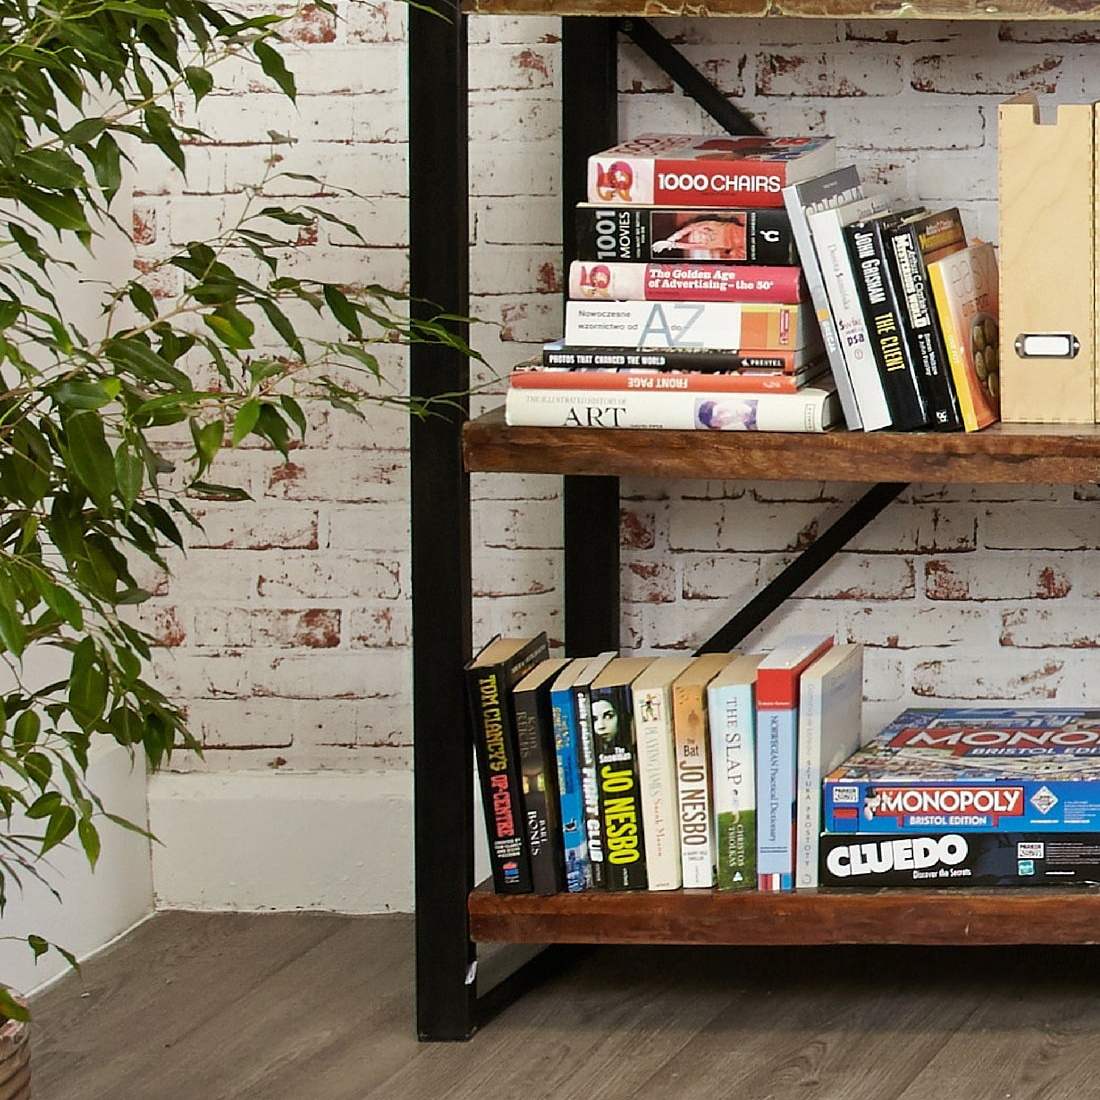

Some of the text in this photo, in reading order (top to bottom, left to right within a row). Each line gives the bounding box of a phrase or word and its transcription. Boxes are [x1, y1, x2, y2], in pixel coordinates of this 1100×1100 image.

[658, 173, 781, 193] 1000 CHAIRS
[595, 210, 617, 260] 1001
[620, 211, 631, 259] MOVIES
[648, 279, 660, 289] of
[662, 280, 727, 291] Advertising
[736, 281, 754, 290] the
[649, 269, 736, 281] The Golden Age
[578, 309, 631, 318] Nowoczesne
[854, 232, 906, 373] JOHN GRISHAM THE CLIENT
[907, 294, 928, 329] WORLD
[578, 303, 706, 347] wzornictwo od A do Z
[847, 333, 865, 347] psa
[549, 354, 666, 366] PHOTOS THAT CHANGED THE WORLD
[750, 359, 783, 367] PRESTEL
[627, 377, 688, 389] FRONT PAGE
[562, 406, 627, 427] ART
[479, 674, 499, 708] TOM
[484, 708, 508, 771] CLANCY'S
[683, 744, 700, 757] Bat
[724, 696, 743, 786] THE SLAP
[969, 746, 1057, 756] BRISTOL
[679, 760, 705, 783] JO
[768, 715, 780, 842] NORWEGIAN Practical Dictionary
[491, 774, 515, 838] OP-CENTRE
[582, 767, 600, 816] FIGHT
[880, 790, 1021, 812] MONOPOLY
[600, 765, 641, 865] JO NESBO
[680, 789, 708, 846] NESBO
[909, 815, 988, 825] BRISTOL EDITION
[527, 810, 541, 856] BONES
[586, 819, 603, 862] CLUB
[826, 833, 969, 877] CLUEDO
[912, 868, 972, 880] Discover the Secrets
